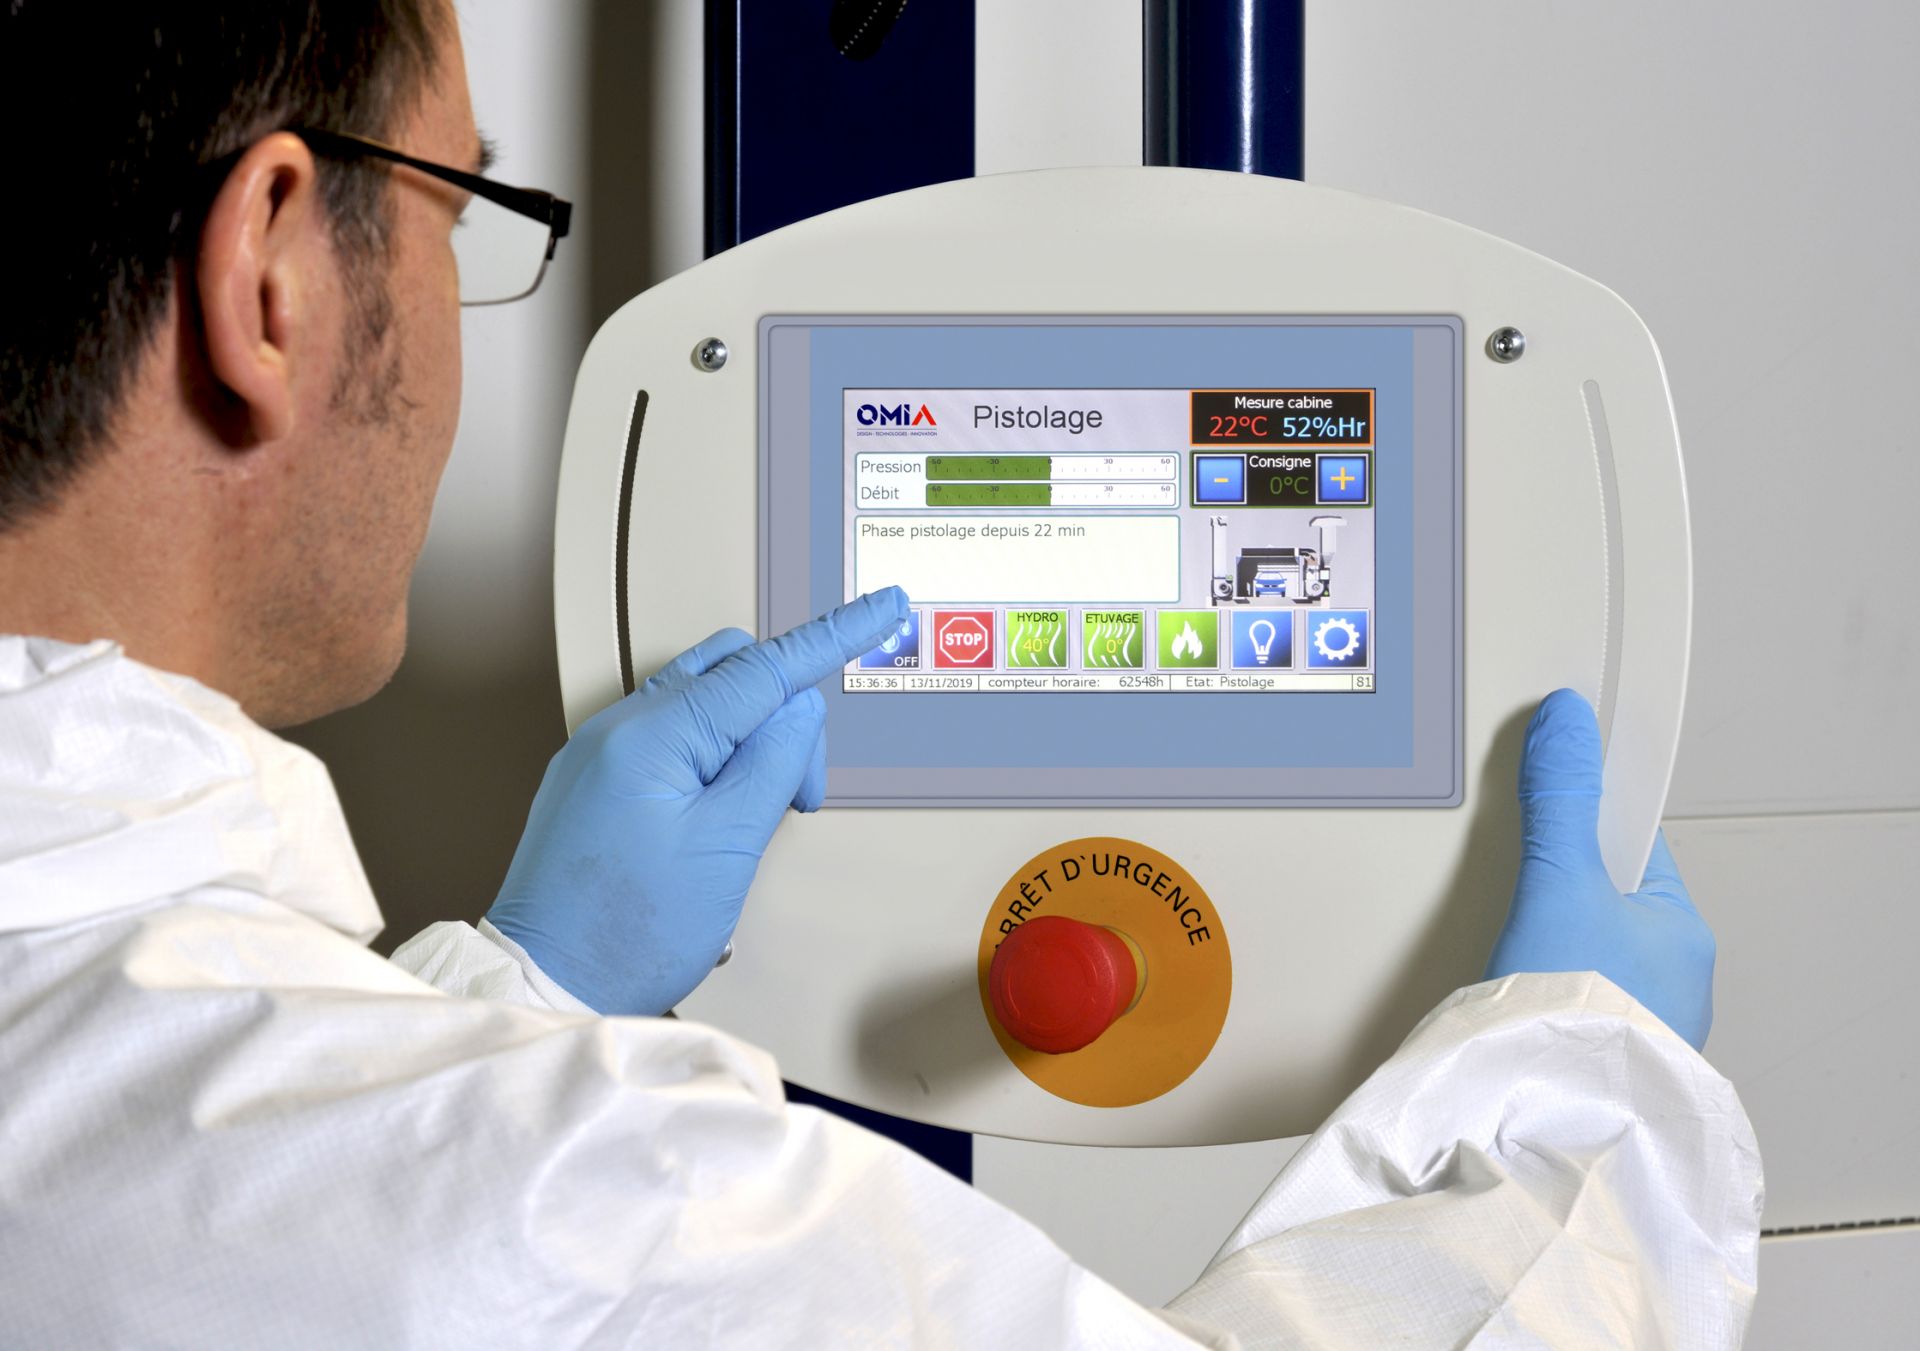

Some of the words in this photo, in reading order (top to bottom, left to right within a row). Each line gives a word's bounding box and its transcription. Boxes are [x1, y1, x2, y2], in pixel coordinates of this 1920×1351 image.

[1234, 397, 1284, 409] Mesure
[1288, 396, 1333, 409] cabine
[857, 404, 937, 426] OMIA
[974, 405, 1103, 435] Pistolage
[1209, 416, 1268, 437] 22°C
[1283, 417, 1366, 437] 52%Hr
[861, 460, 922, 473] Pression
[1249, 455, 1312, 471] Consigne
[1269, 476, 1310, 495] 0°C
[861, 486, 900, 500] Débit
[862, 524, 905, 537] Phase
[910, 524, 976, 540] pistolage
[981, 524, 1029, 540] depuis
[1034, 524, 1052, 537] 22
[1058, 524, 1085, 537] min
[1016, 612, 1059, 623] HYDRO
[1085, 613, 1139, 624] ETUVAGE
[945, 633, 983, 646] STOP
[1023, 638, 1049, 652] 40°
[894, 656, 919, 667] OFF
[849, 678, 898, 688] 15:36:36
[911, 677, 973, 689] 13/11/2019
[988, 678, 1048, 690] compteur
[1053, 677, 1101, 688] horaire:
[1119, 676, 1164, 687] 62548h
[1186, 677, 1214, 688] Etat:
[1220, 676, 1275, 689] Pistolage
[1356, 676, 1372, 688] 81
[995, 869, 1052, 950] RRÊT
